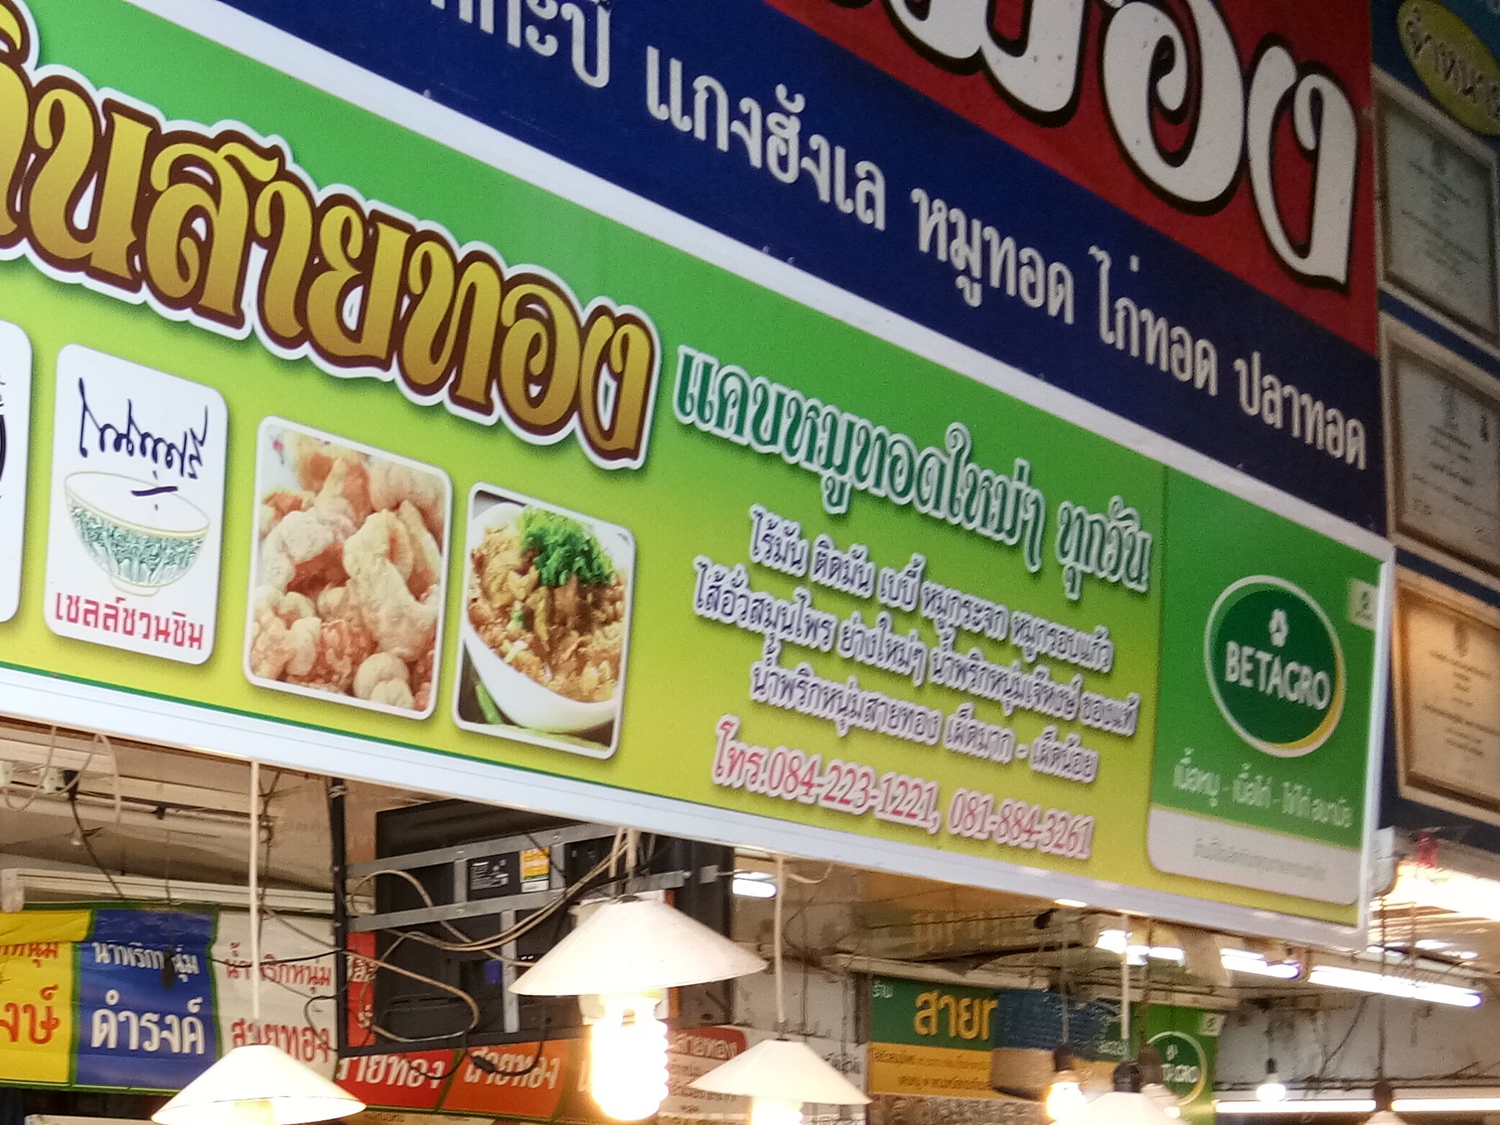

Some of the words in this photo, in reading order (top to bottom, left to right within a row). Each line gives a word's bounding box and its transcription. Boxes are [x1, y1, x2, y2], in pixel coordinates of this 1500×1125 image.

[646, 45, 886, 231] แกงฮังเล
[910, 187, 1075, 308] หมูทอด
[1088, 244, 1218, 396] ไก่ทอด
[1233, 350, 1368, 471] ปลาทอด
[811, 534, 875, 597] ติดมัน
[1056, 497, 1152, 600] ทุกวัน
[55, 592, 204, 650] เชลล์ชวนชิม
[1224, 641, 1331, 711] BETAGRO
[90, 988, 206, 1055] ดำรงค์
